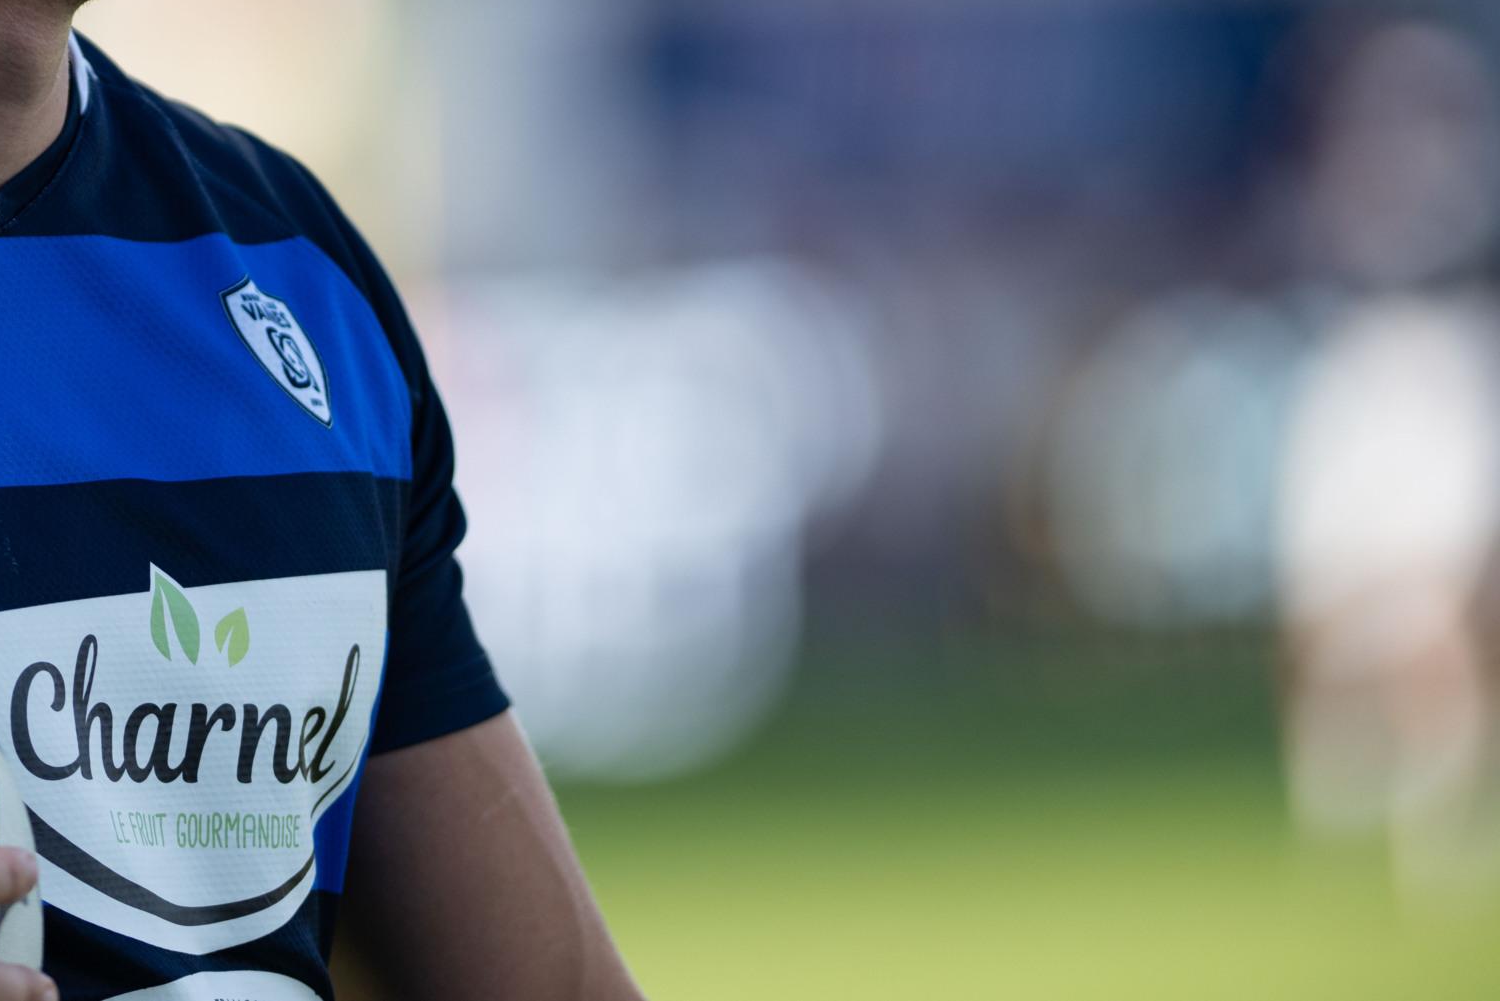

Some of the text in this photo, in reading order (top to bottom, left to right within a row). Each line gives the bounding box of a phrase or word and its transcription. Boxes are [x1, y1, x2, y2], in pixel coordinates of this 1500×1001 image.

[10, 634, 360, 784] Charnel
[110, 810, 301, 849] LE FRUIT GOURMANDISE
